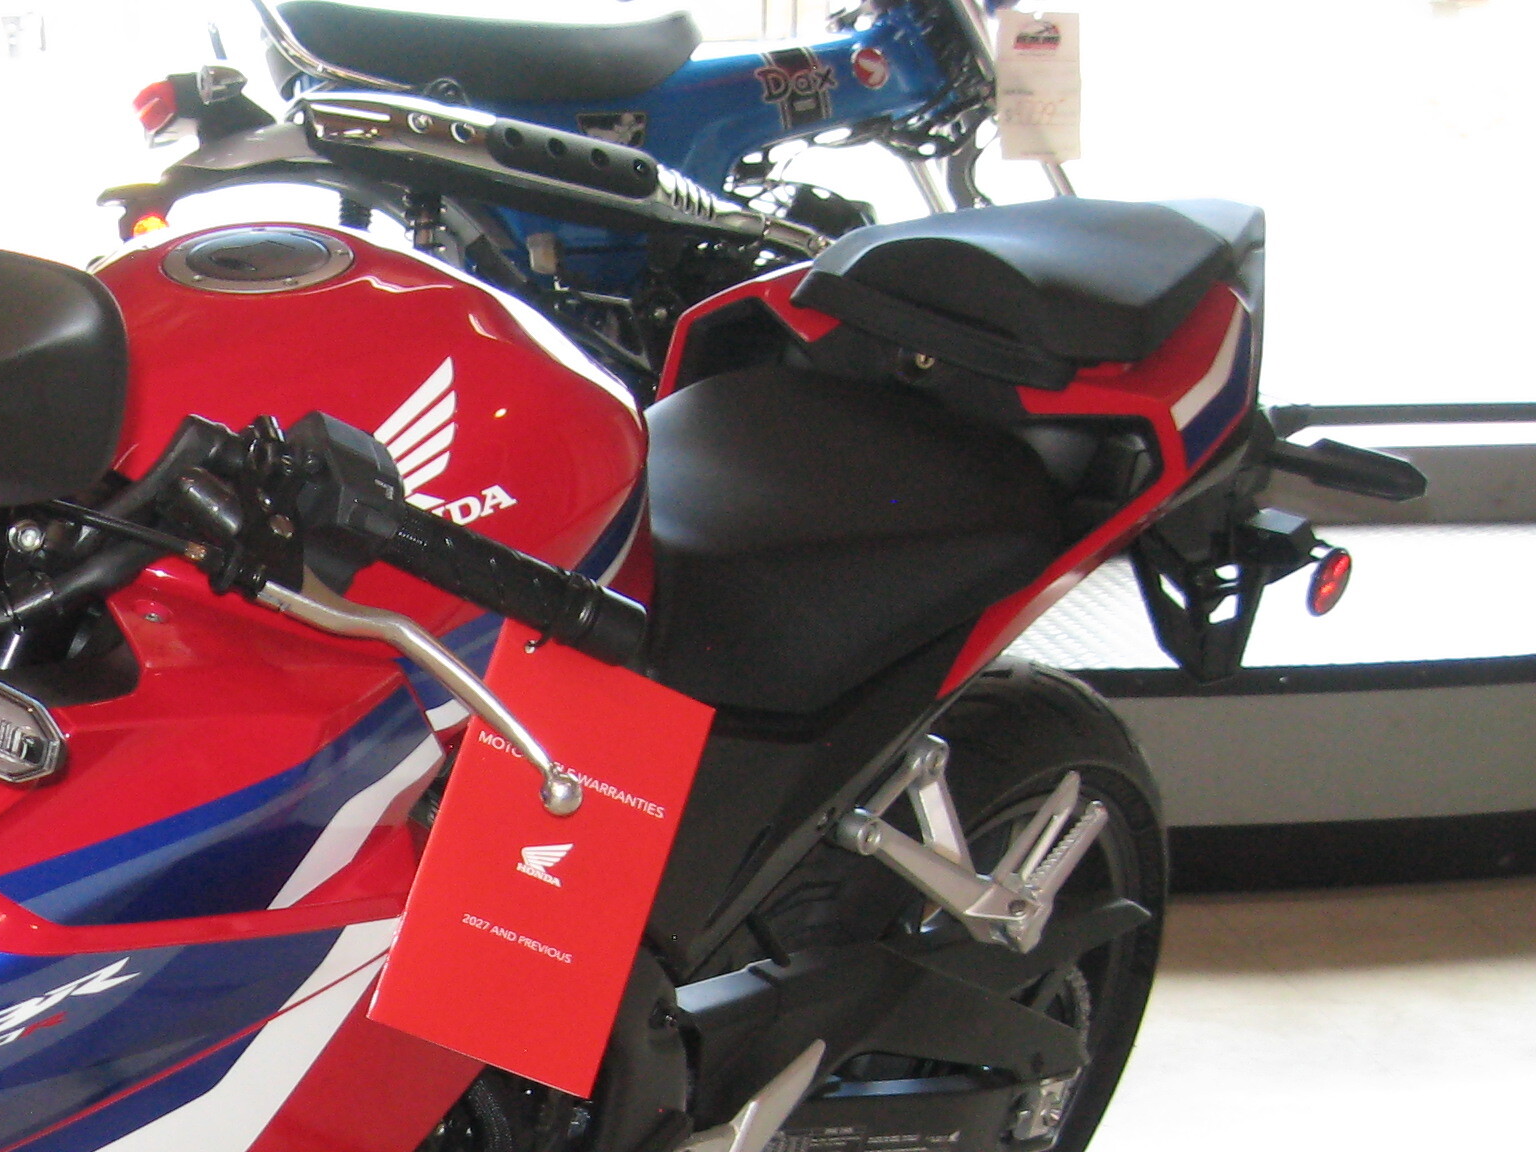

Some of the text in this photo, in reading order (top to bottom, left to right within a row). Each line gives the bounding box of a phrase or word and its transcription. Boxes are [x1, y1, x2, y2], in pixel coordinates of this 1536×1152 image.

[754, 64, 838, 103] Dax
[577, 771, 666, 819] WARRANTIES
[516, 862, 562, 888] HONDA
[462, 913, 573, 964] 2027 AND PREVIOUS
